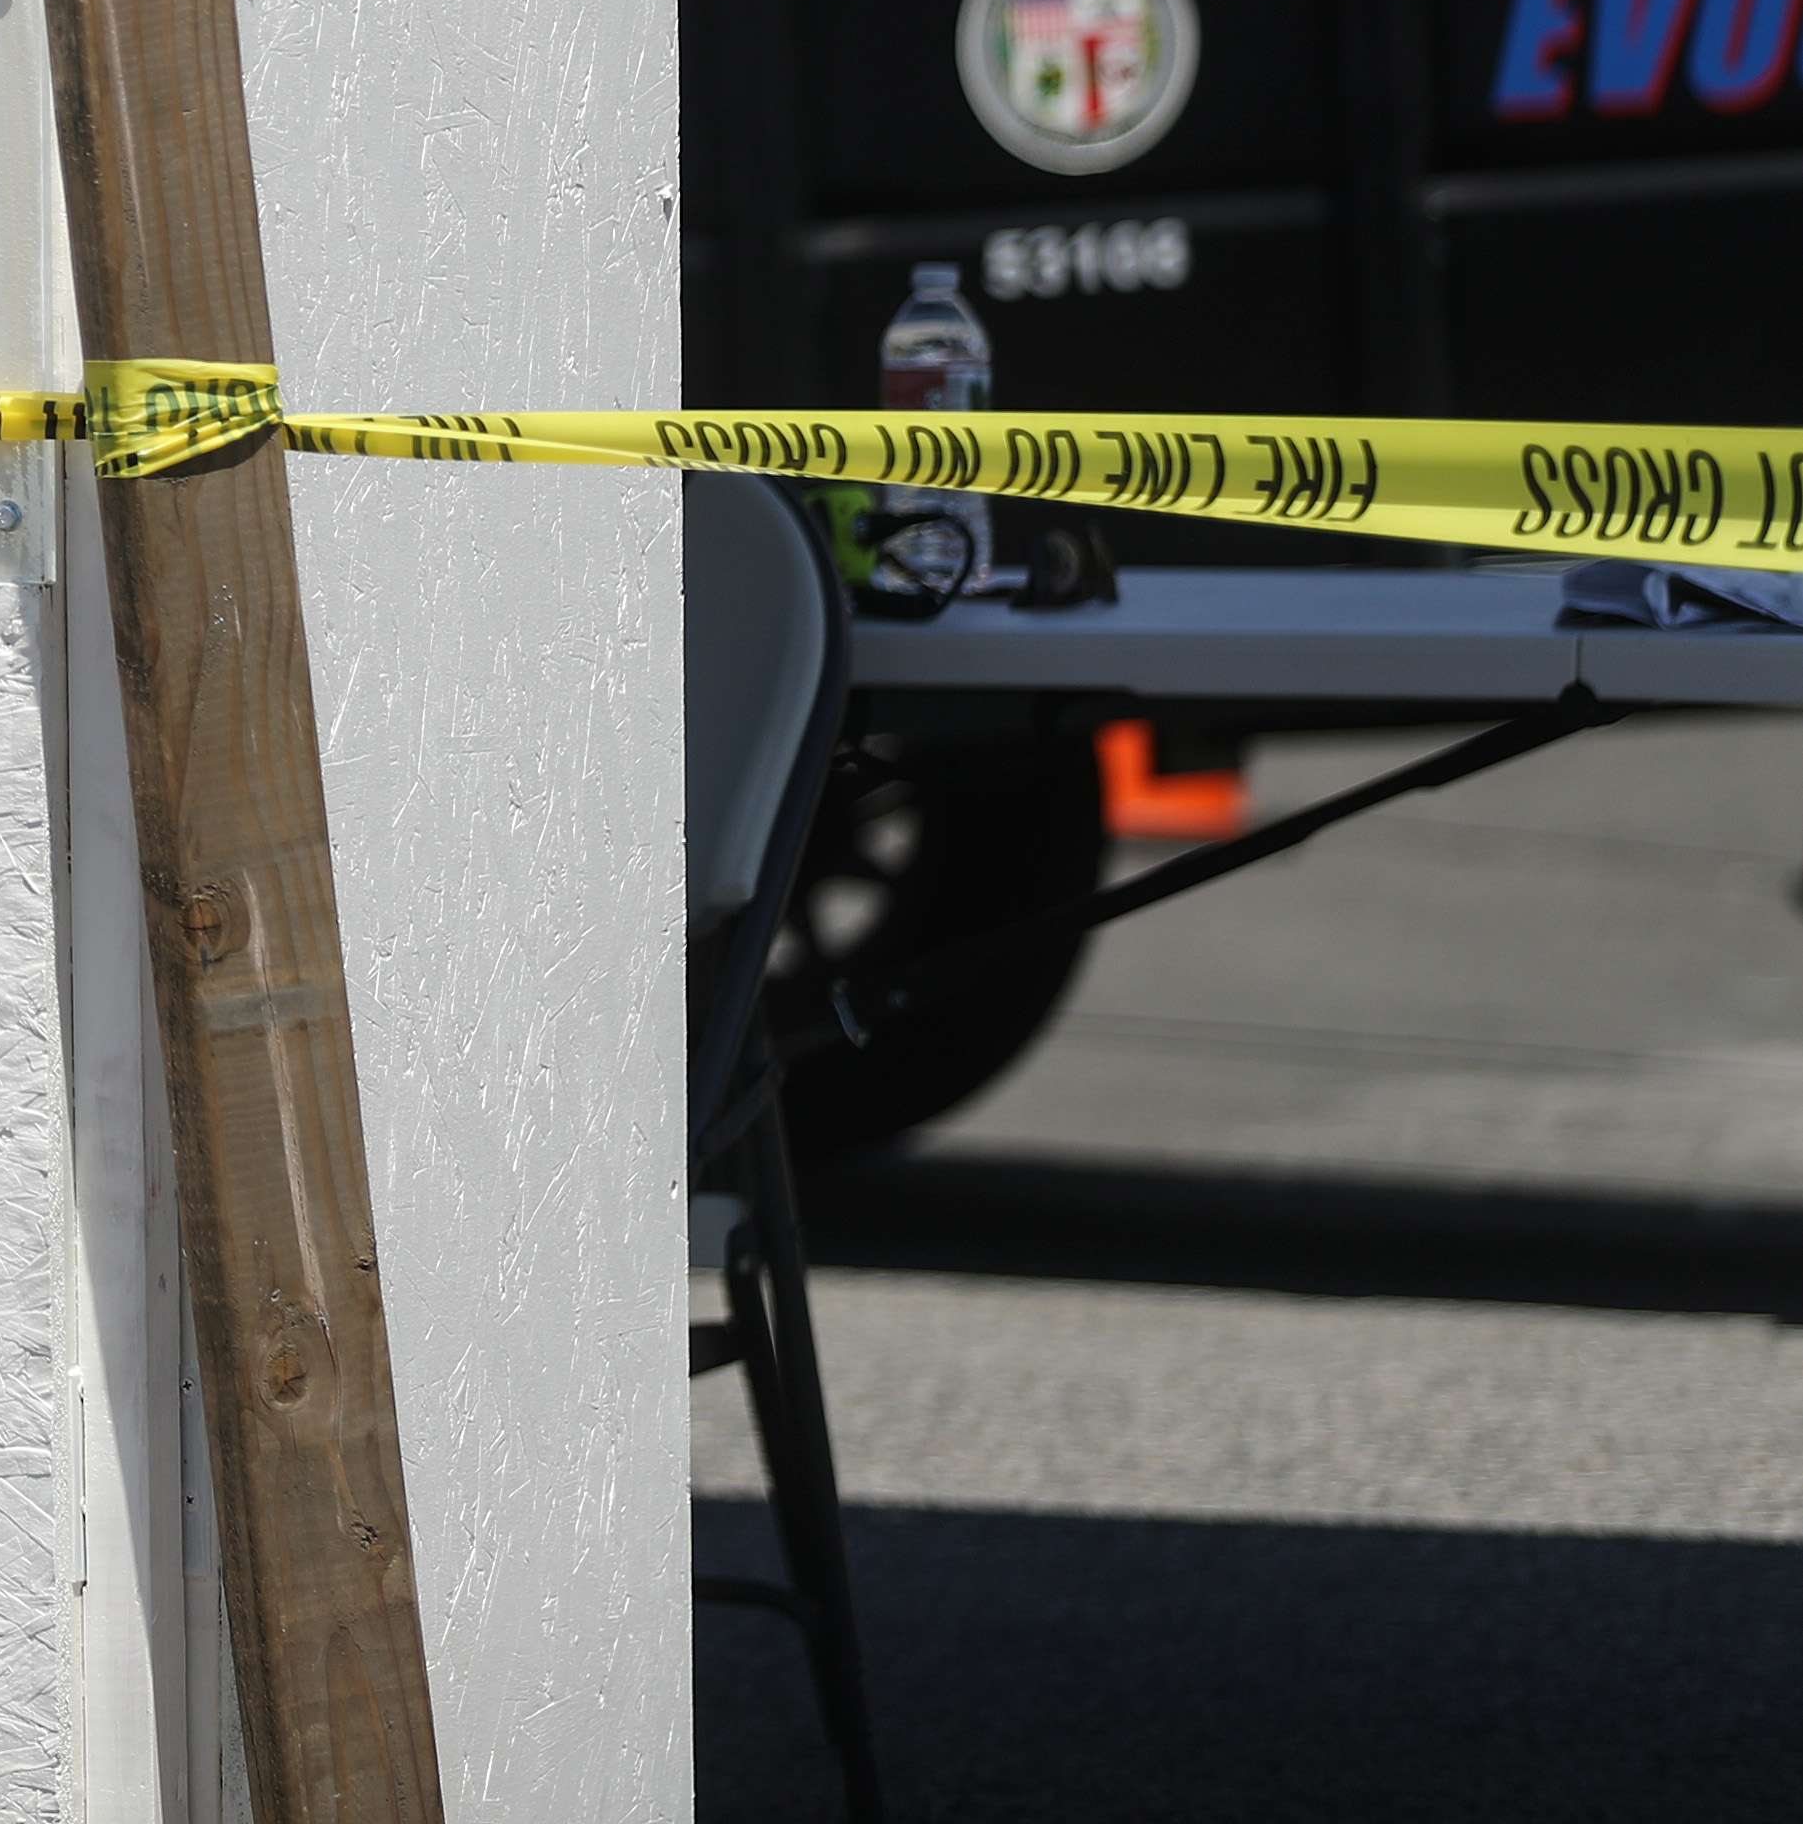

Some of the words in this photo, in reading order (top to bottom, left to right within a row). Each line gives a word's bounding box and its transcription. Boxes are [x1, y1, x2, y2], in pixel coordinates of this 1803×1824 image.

[994, 428, 1081, 498] DO
[1086, 430, 1226, 511] LINE
[1232, 434, 1378, 522] FIRE
[1512, 443, 1723, 547] CROSS
